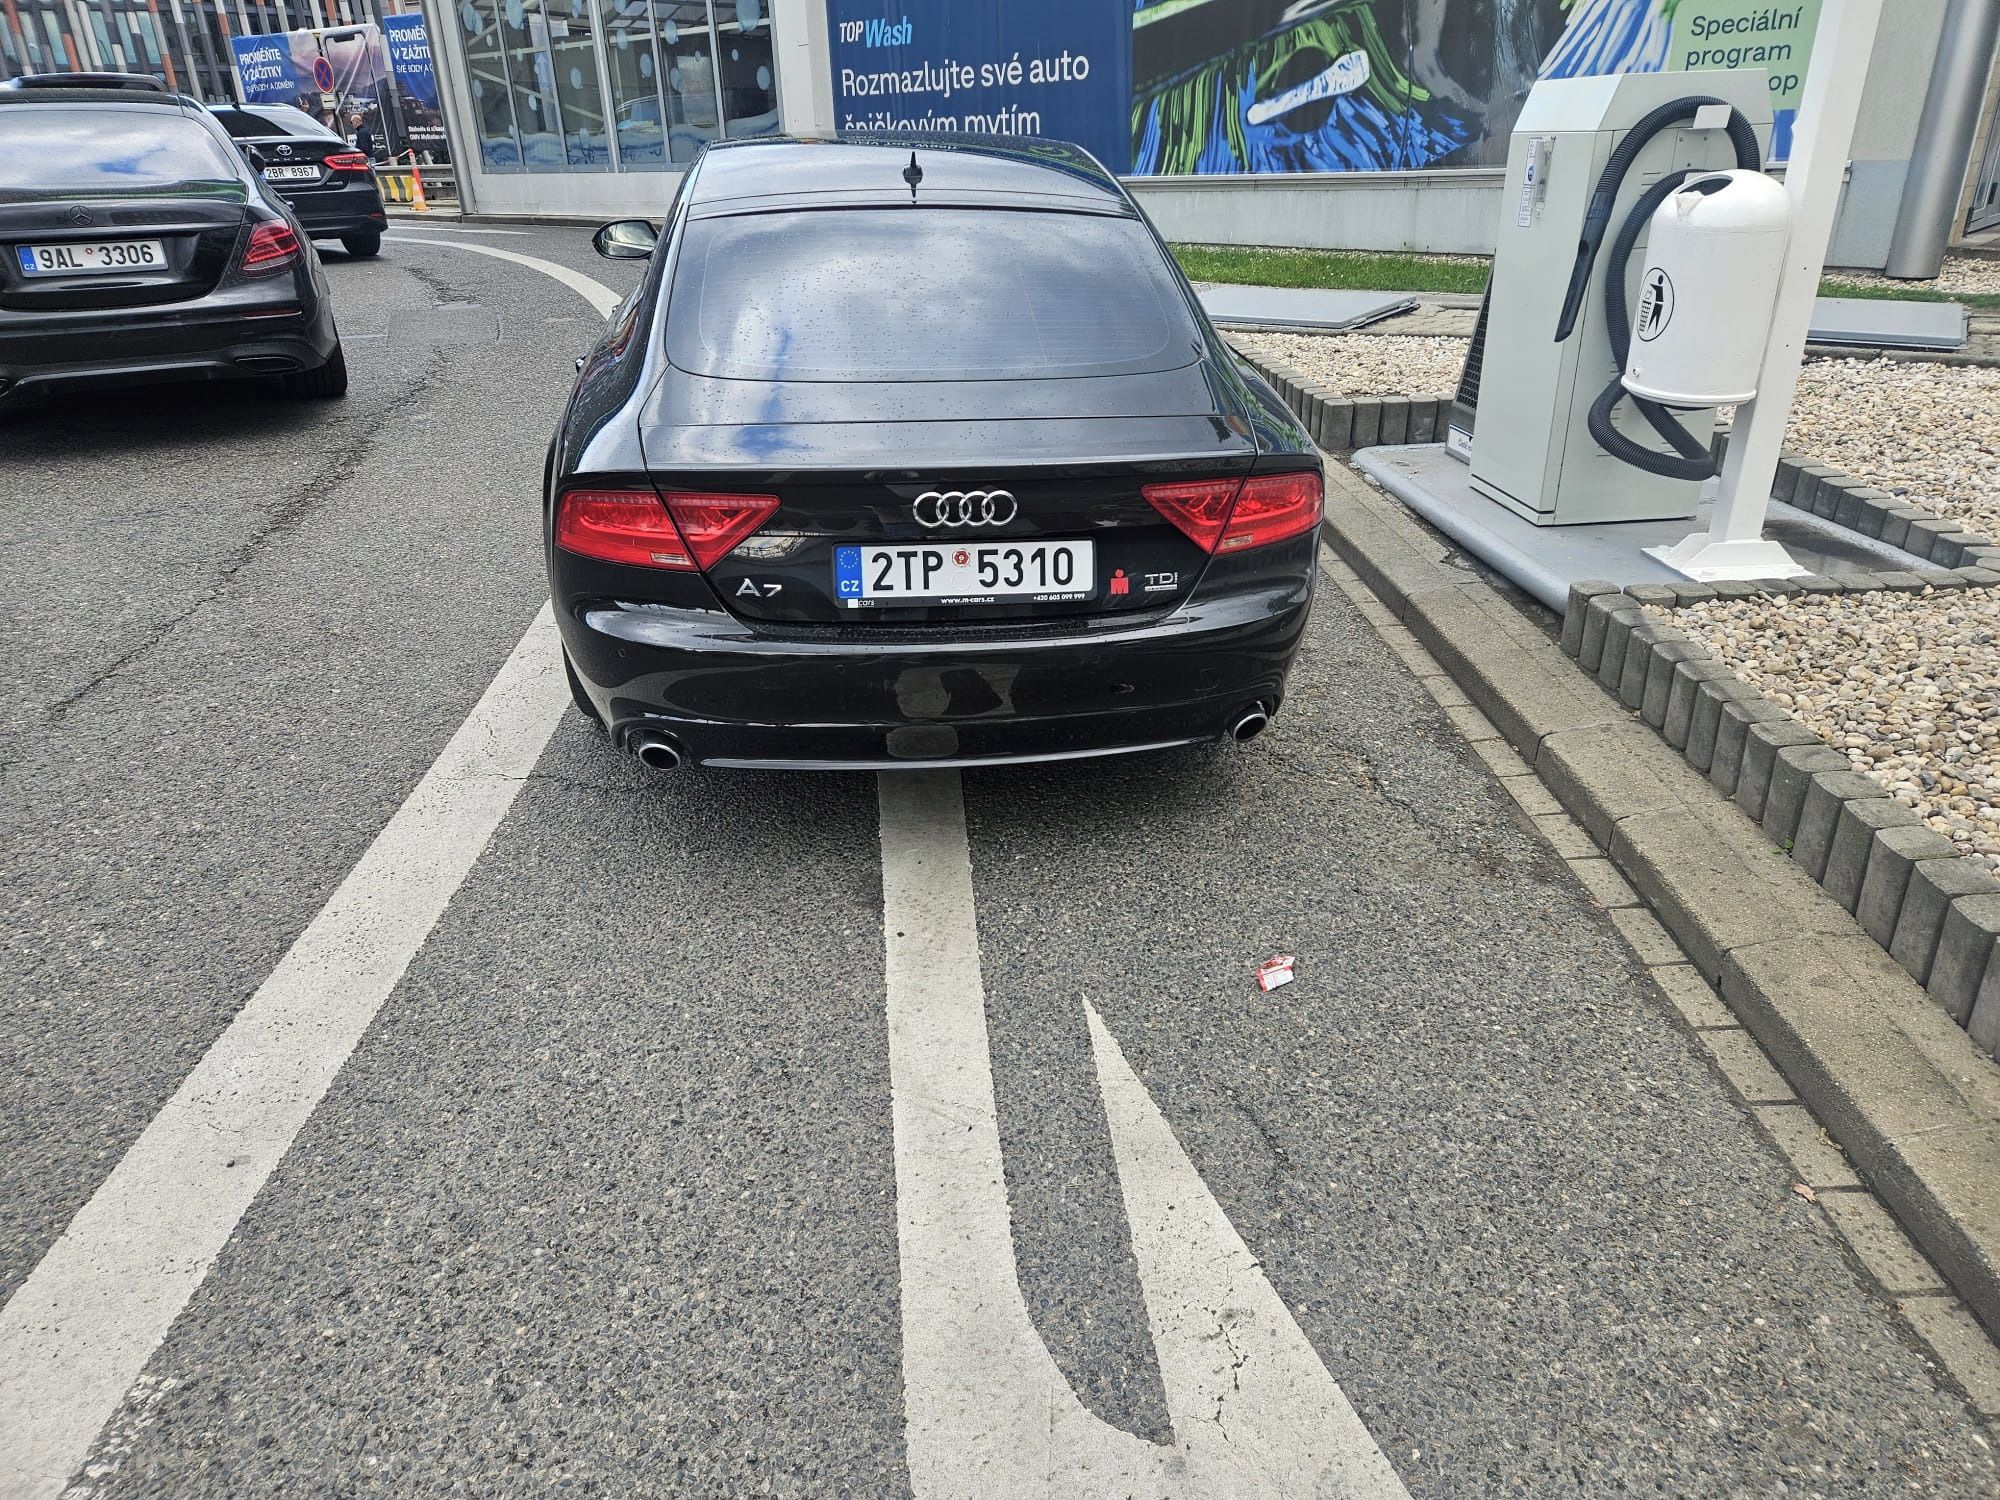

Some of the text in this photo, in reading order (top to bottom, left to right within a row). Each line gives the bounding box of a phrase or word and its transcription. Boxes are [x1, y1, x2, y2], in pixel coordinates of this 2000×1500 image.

[839, 15, 912, 48] TOP Wash
[1691, 6, 1803, 40] Speciální
[392, 47, 399, 59] V
[1685, 44, 1791, 71] program
[842, 50, 1089, 97] Rozmazlujte své auto
[266, 167, 285, 178] 2BR
[291, 166, 314, 177] 8967
[39, 244, 154, 269] 9AL 3306
[871, 547, 1073, 591] 2TP 5310
[1144, 572, 1178, 585] TDI
[735, 578, 782, 597] A7
[841, 580, 859, 592] CZ
[940, 596, 995, 604] www.m-cars.cz
